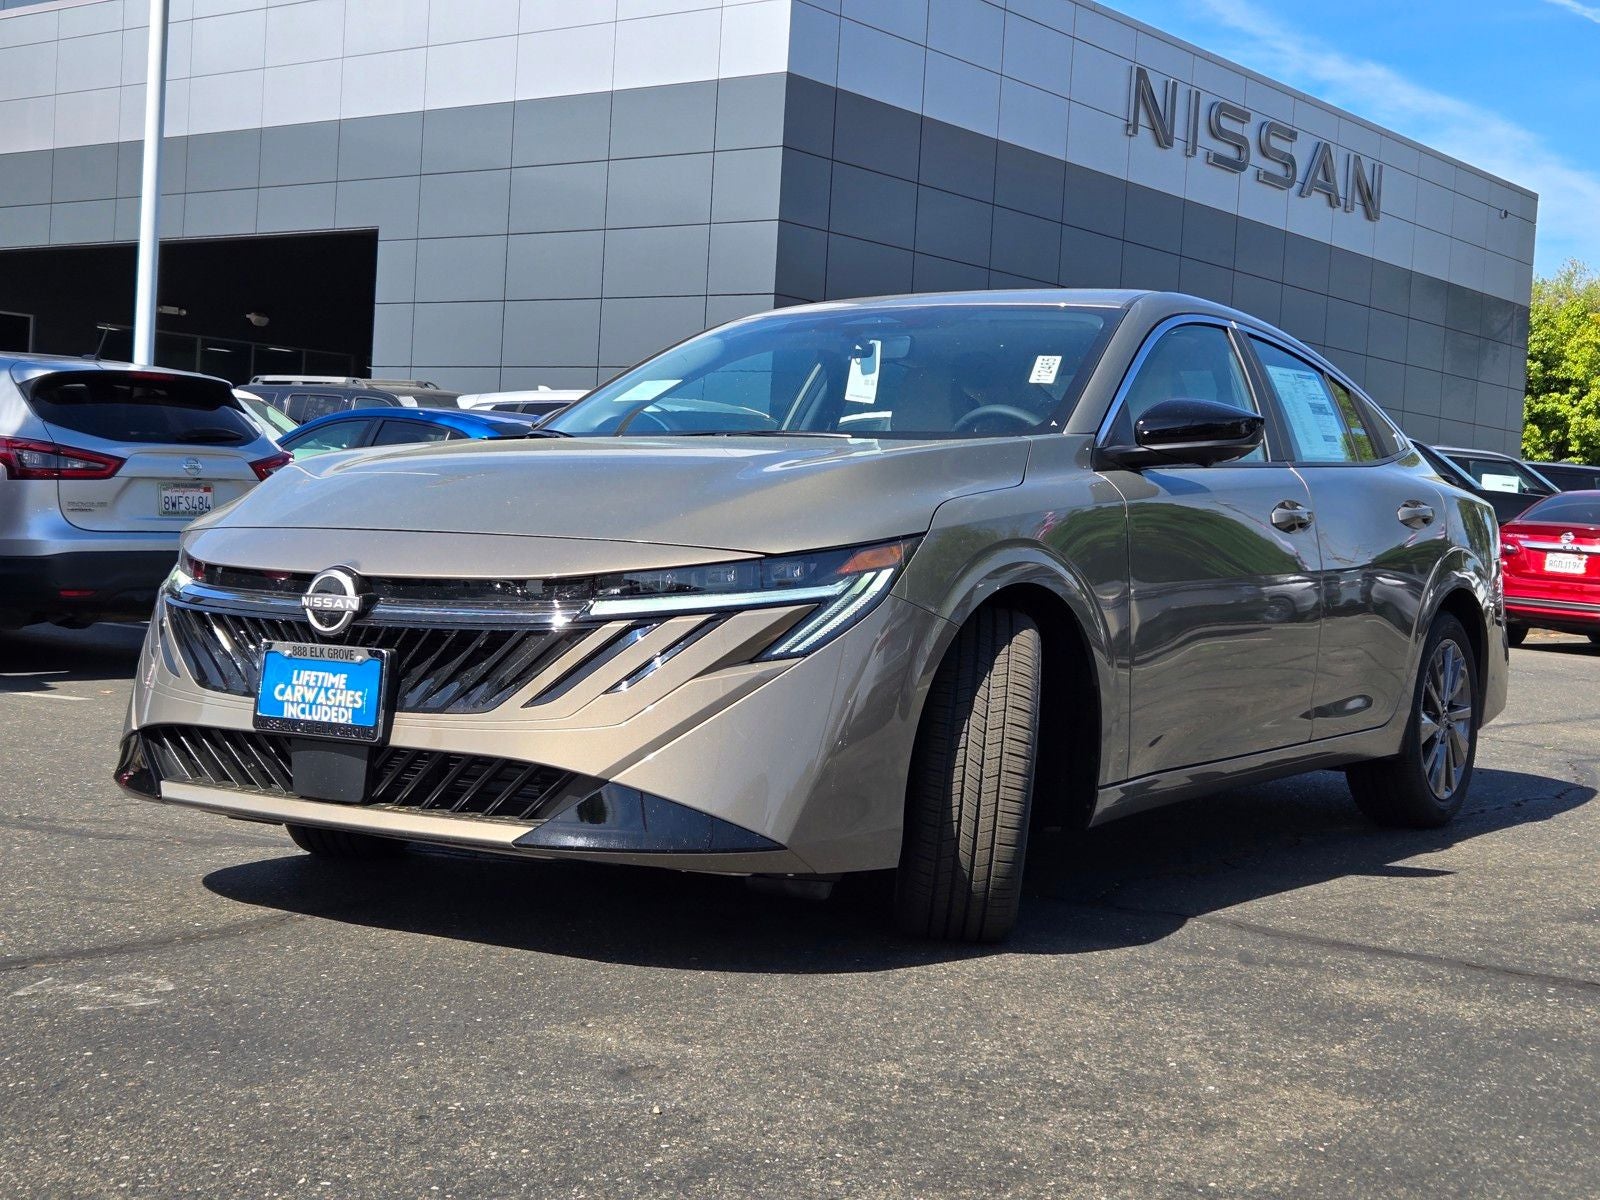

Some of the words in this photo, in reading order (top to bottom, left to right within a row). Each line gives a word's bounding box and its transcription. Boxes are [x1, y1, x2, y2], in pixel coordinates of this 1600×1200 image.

[1126, 65, 1383, 221] NISSAN
[163, 495, 211, 512] 8WFS484
[301, 596, 359, 610] NISSAN
[292, 645, 308, 657] 888
[310, 647, 325, 658] ELK
[327, 648, 354, 660] GROVE
[292, 669, 348, 689] LIFETIME
[273, 684, 363, 709] CARWASHES
[283, 702, 353, 724] INCLUDED!
